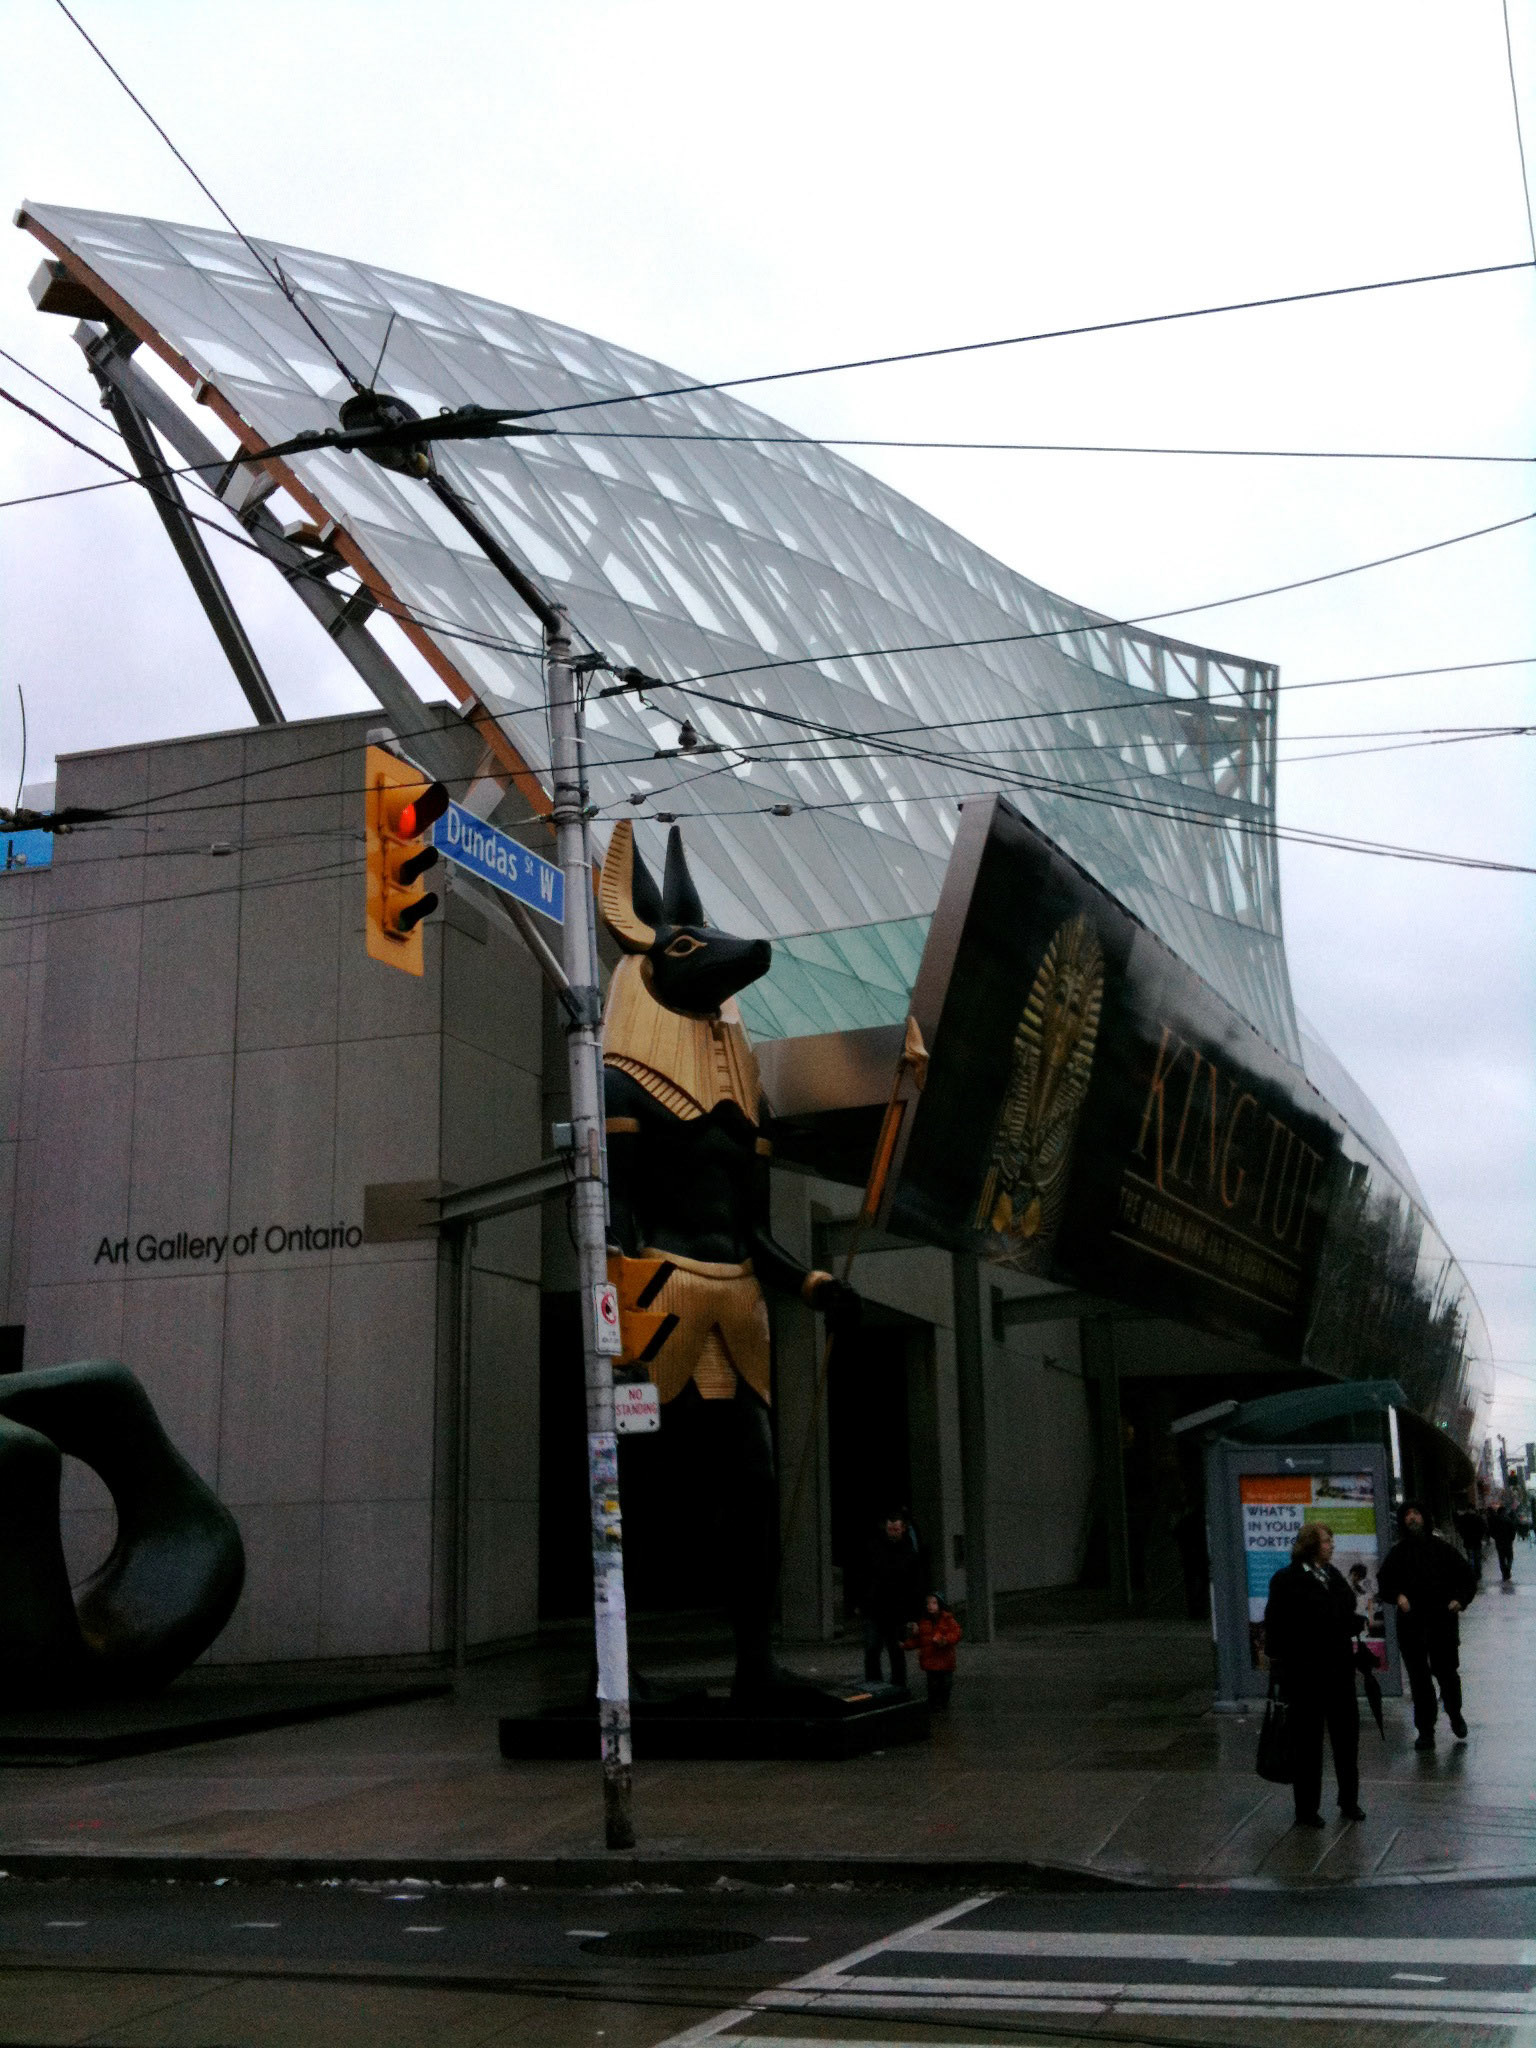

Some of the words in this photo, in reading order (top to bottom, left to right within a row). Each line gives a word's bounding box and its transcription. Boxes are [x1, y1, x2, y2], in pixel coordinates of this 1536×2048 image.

[447, 806, 518, 881] Dundas
[524, 855, 534, 877] St
[540, 865, 555, 903] W
[1132, 1024, 1258, 1208] KING
[1252, 1111, 1324, 1250] TUT
[94, 1237, 129, 1265] Art
[136, 1232, 228, 1263] Gallery
[233, 1227, 258, 1256] of
[265, 1222, 363, 1254] Ontario
[628, 1388, 643, 1400] NO
[616, 1403, 657, 1416] STANDING
[1247, 1506, 1297, 1517] WHAT'S
[1248, 1521, 1261, 1532] IN
[1265, 1521, 1301, 1532] YOUR
